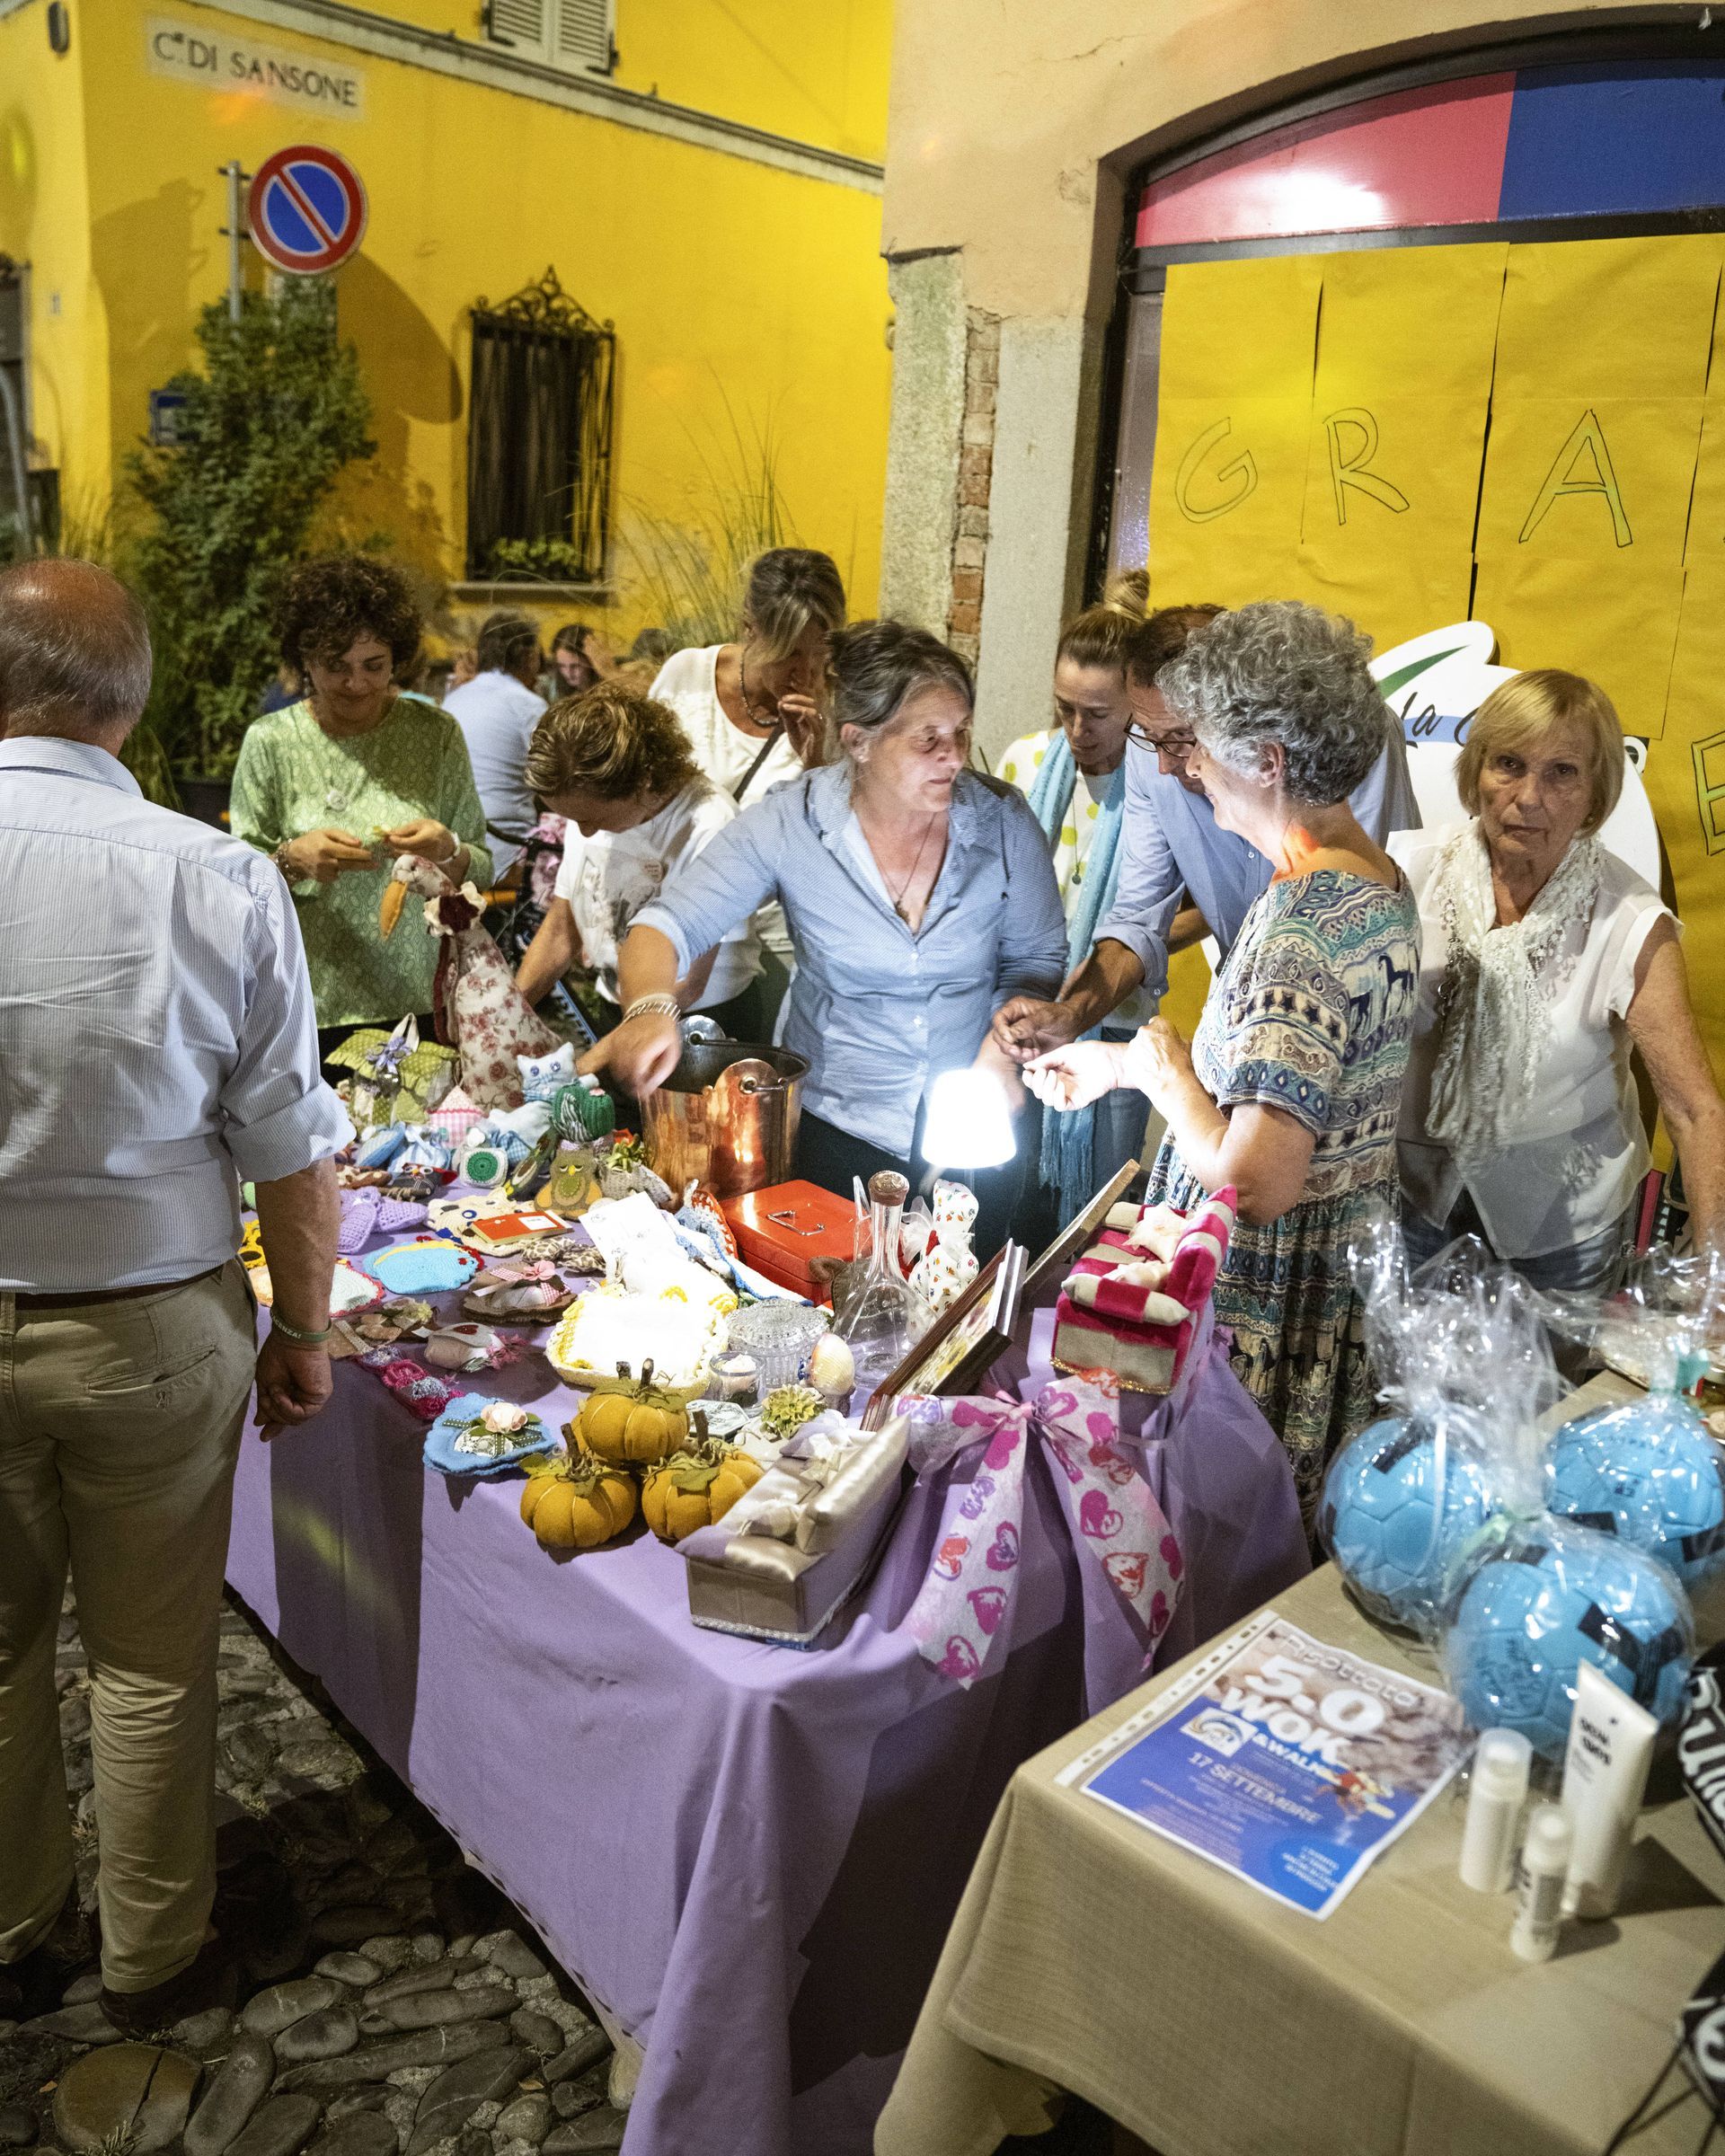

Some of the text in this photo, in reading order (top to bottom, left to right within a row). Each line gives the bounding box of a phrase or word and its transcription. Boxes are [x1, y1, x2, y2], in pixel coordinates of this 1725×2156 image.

[188, 39, 217, 72] DI
[228, 50, 358, 107] SANSONE
[1219, 1686, 1351, 1763] WOK
[1244, 1654, 1384, 1734] 5.0
[1188, 1751, 1213, 1769] 17
[1210, 1763, 1323, 1825] SETTEMBRE
